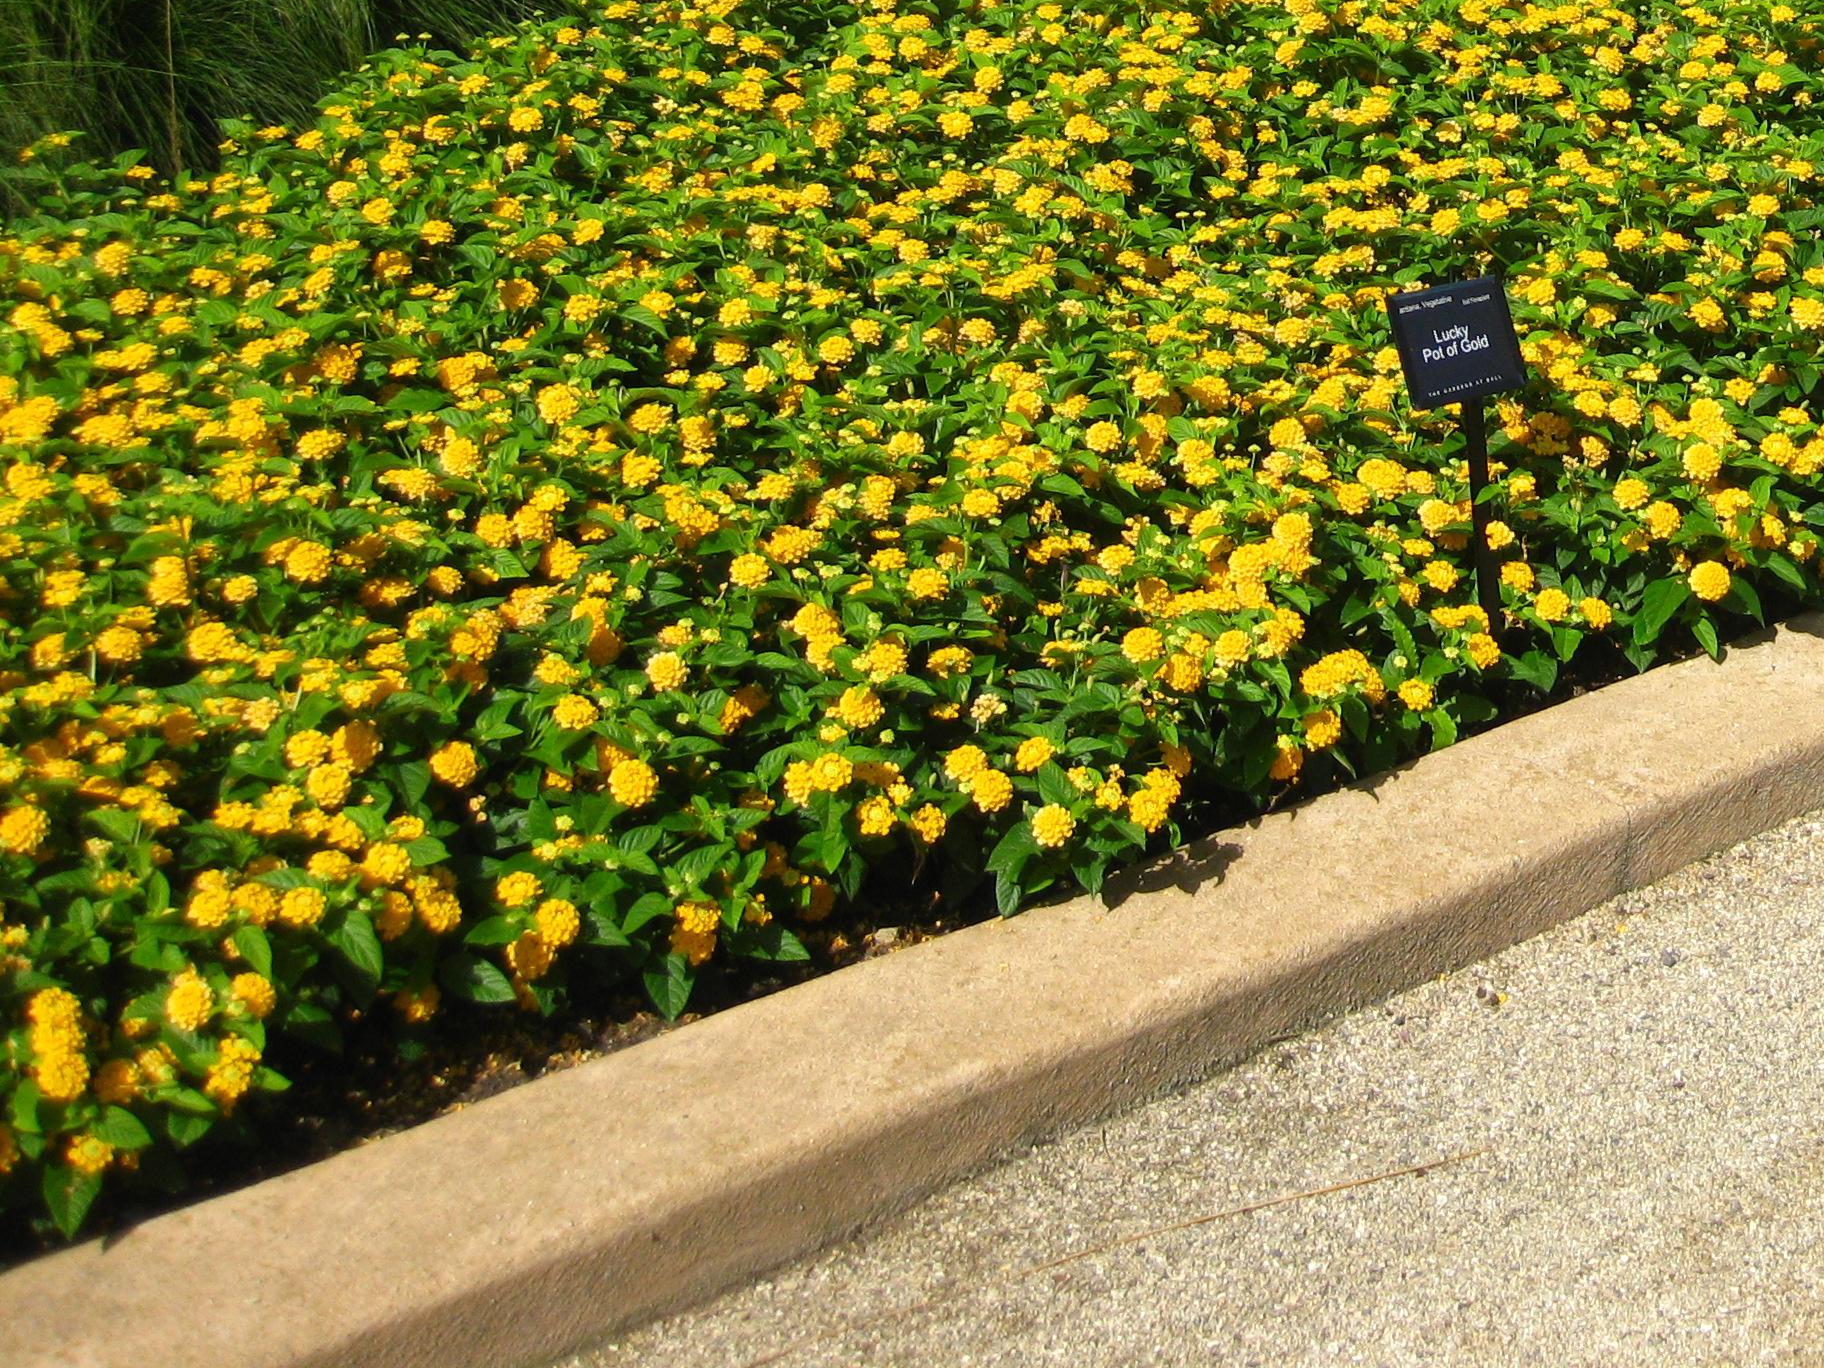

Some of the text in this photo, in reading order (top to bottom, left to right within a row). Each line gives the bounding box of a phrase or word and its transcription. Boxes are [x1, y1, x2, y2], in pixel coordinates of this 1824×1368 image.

[1433, 324, 1469, 344] Lucky
[1422, 333, 1490, 364] Pot of Gold
